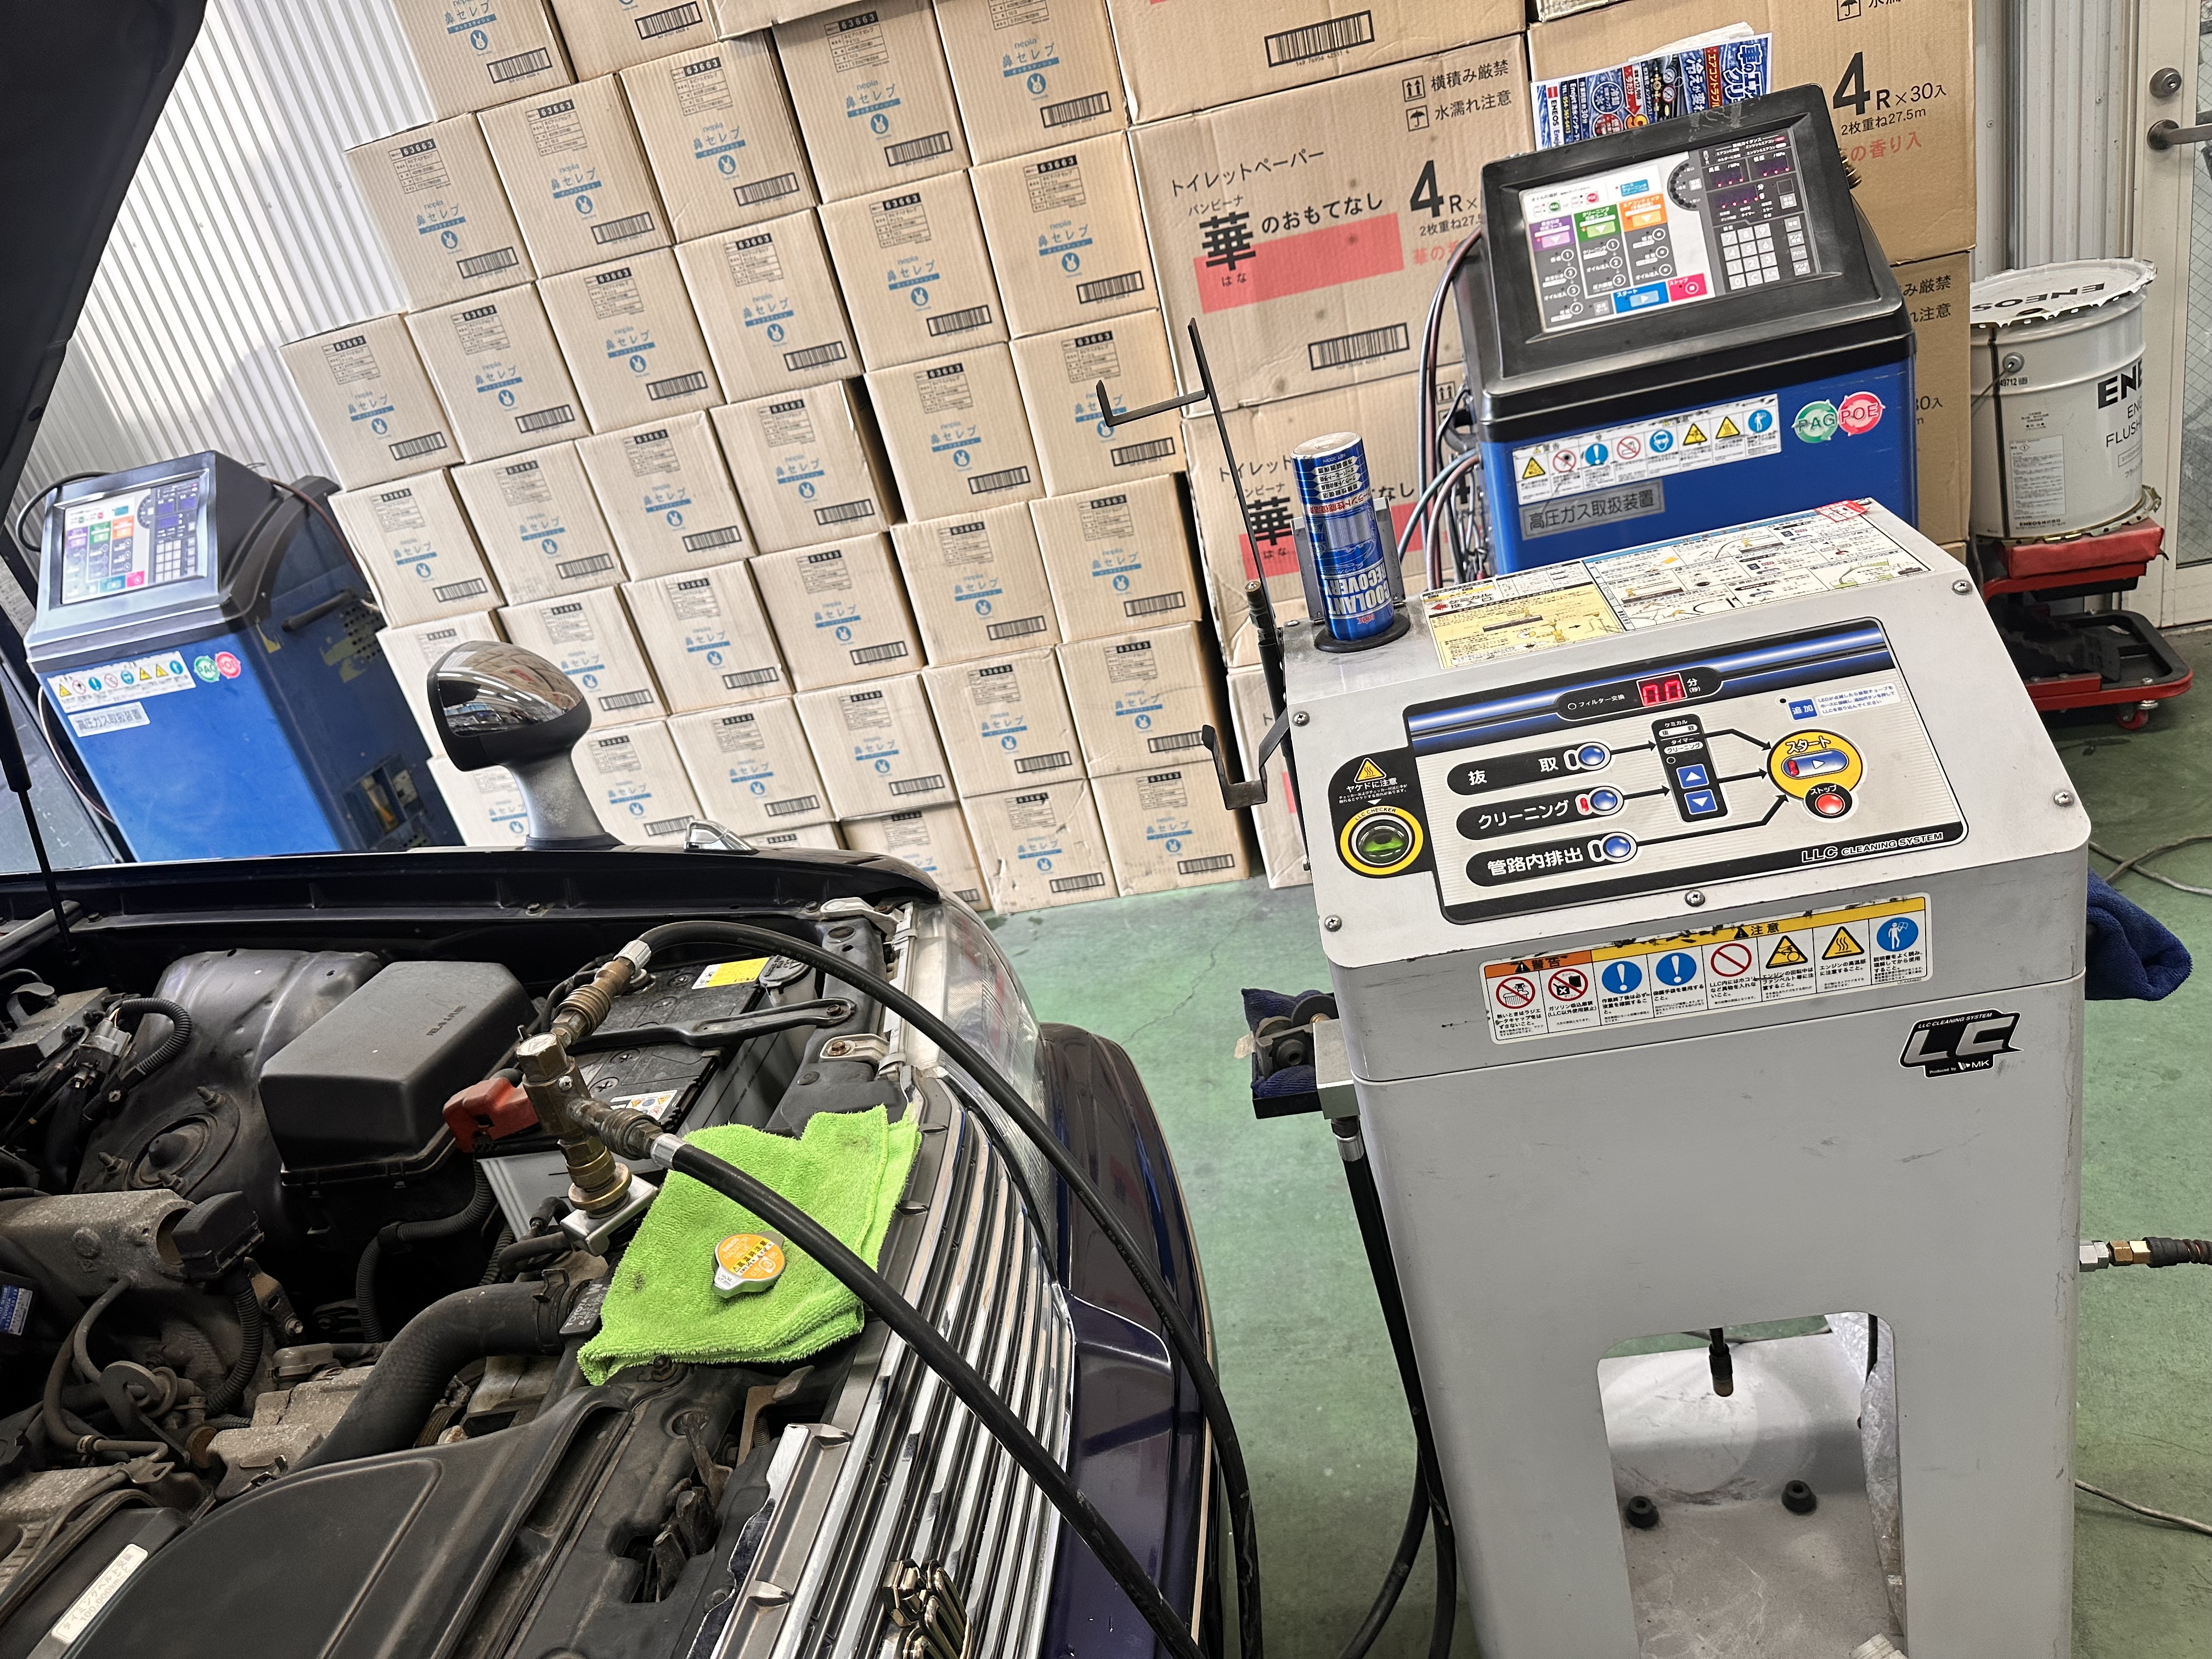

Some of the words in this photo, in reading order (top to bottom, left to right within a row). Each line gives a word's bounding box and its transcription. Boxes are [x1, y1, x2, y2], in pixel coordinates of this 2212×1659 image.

[840, 13, 877, 31] 63663
[686, 59, 719, 75] 63663
[1431, 60, 1509, 91] 横積み厳禁
[1625, 76, 1634, 95] 今だけ
[539, 100, 572, 117] 63663
[1434, 89, 1512, 121] 水濡れ注意
[1551, 100, 1559, 126] ENEOS
[1841, 109, 1926, 136] 2枚重ね27.5m
[402, 140, 433, 156] 63663
[1040, 157, 1075, 173] 63663
[1171, 149, 1324, 196] トイレットペーパー
[885, 194, 919, 210] 63663
[1188, 195, 1244, 216] バンビーナ
[1199, 212, 1256, 271] 華
[1262, 193, 1383, 234] のおもてなし
[738, 234, 770, 249] 63663
[1221, 273, 1247, 287] はな
[1972, 283, 2105, 312] ENEOS
[1077, 332, 1110, 346] 63663
[1841, 404, 1879, 423] POE
[1797, 413, 1836, 433] PAG
[1529, 489, 1654, 529] 高圧ガス取扱装置
[1246, 496, 1294, 545] 華
[1324, 563, 1387, 597] RECOVERY
[1328, 582, 1390, 616] COOLANT
[1686, 678, 1698, 687] 分
[1578, 694, 1625, 708] フィルター交換
[1791, 703, 1814, 715] 追加
[1664, 719, 1688, 728] ケミカル
[1666, 742, 1701, 753] クリーニング
[1671, 736, 1695, 746] タイマー
[1786, 736, 1831, 754] スタート
[1346, 777, 1398, 793] ヤケドに注意
[1809, 784, 1837, 795] ストップ
[1355, 811, 1367, 821] LLC
[1367, 808, 1397, 816] CHECKER
[1478, 800, 1569, 830] クリーニング
[1801, 847, 1839, 862] LLC
[1842, 841, 1897, 856] CLEANING
[1899, 832, 1943, 847] SYSTEM
[1487, 848, 1583, 877] 管路内排出
[1751, 923, 1780, 936] 注意
[1531, 957, 1561, 971] 警告
[1820, 959, 1866, 970] エンジンの高温部
[1820, 966, 1864, 976] に注意すること。
[1710, 981, 1757, 992] など異物を入れな
[1932, 1017, 1965, 1027] CLEANING
[1966, 1012, 1993, 1022] SYSTEM
[1972, 1059, 1990, 1069] MK
[723, 1236, 751, 1260] RADIATOR
[733, 1244, 753, 1260] VALVE
[564, 1296, 590, 1328] TOYOTA
[63, 1553, 134, 1630] タイミングベルト交換
